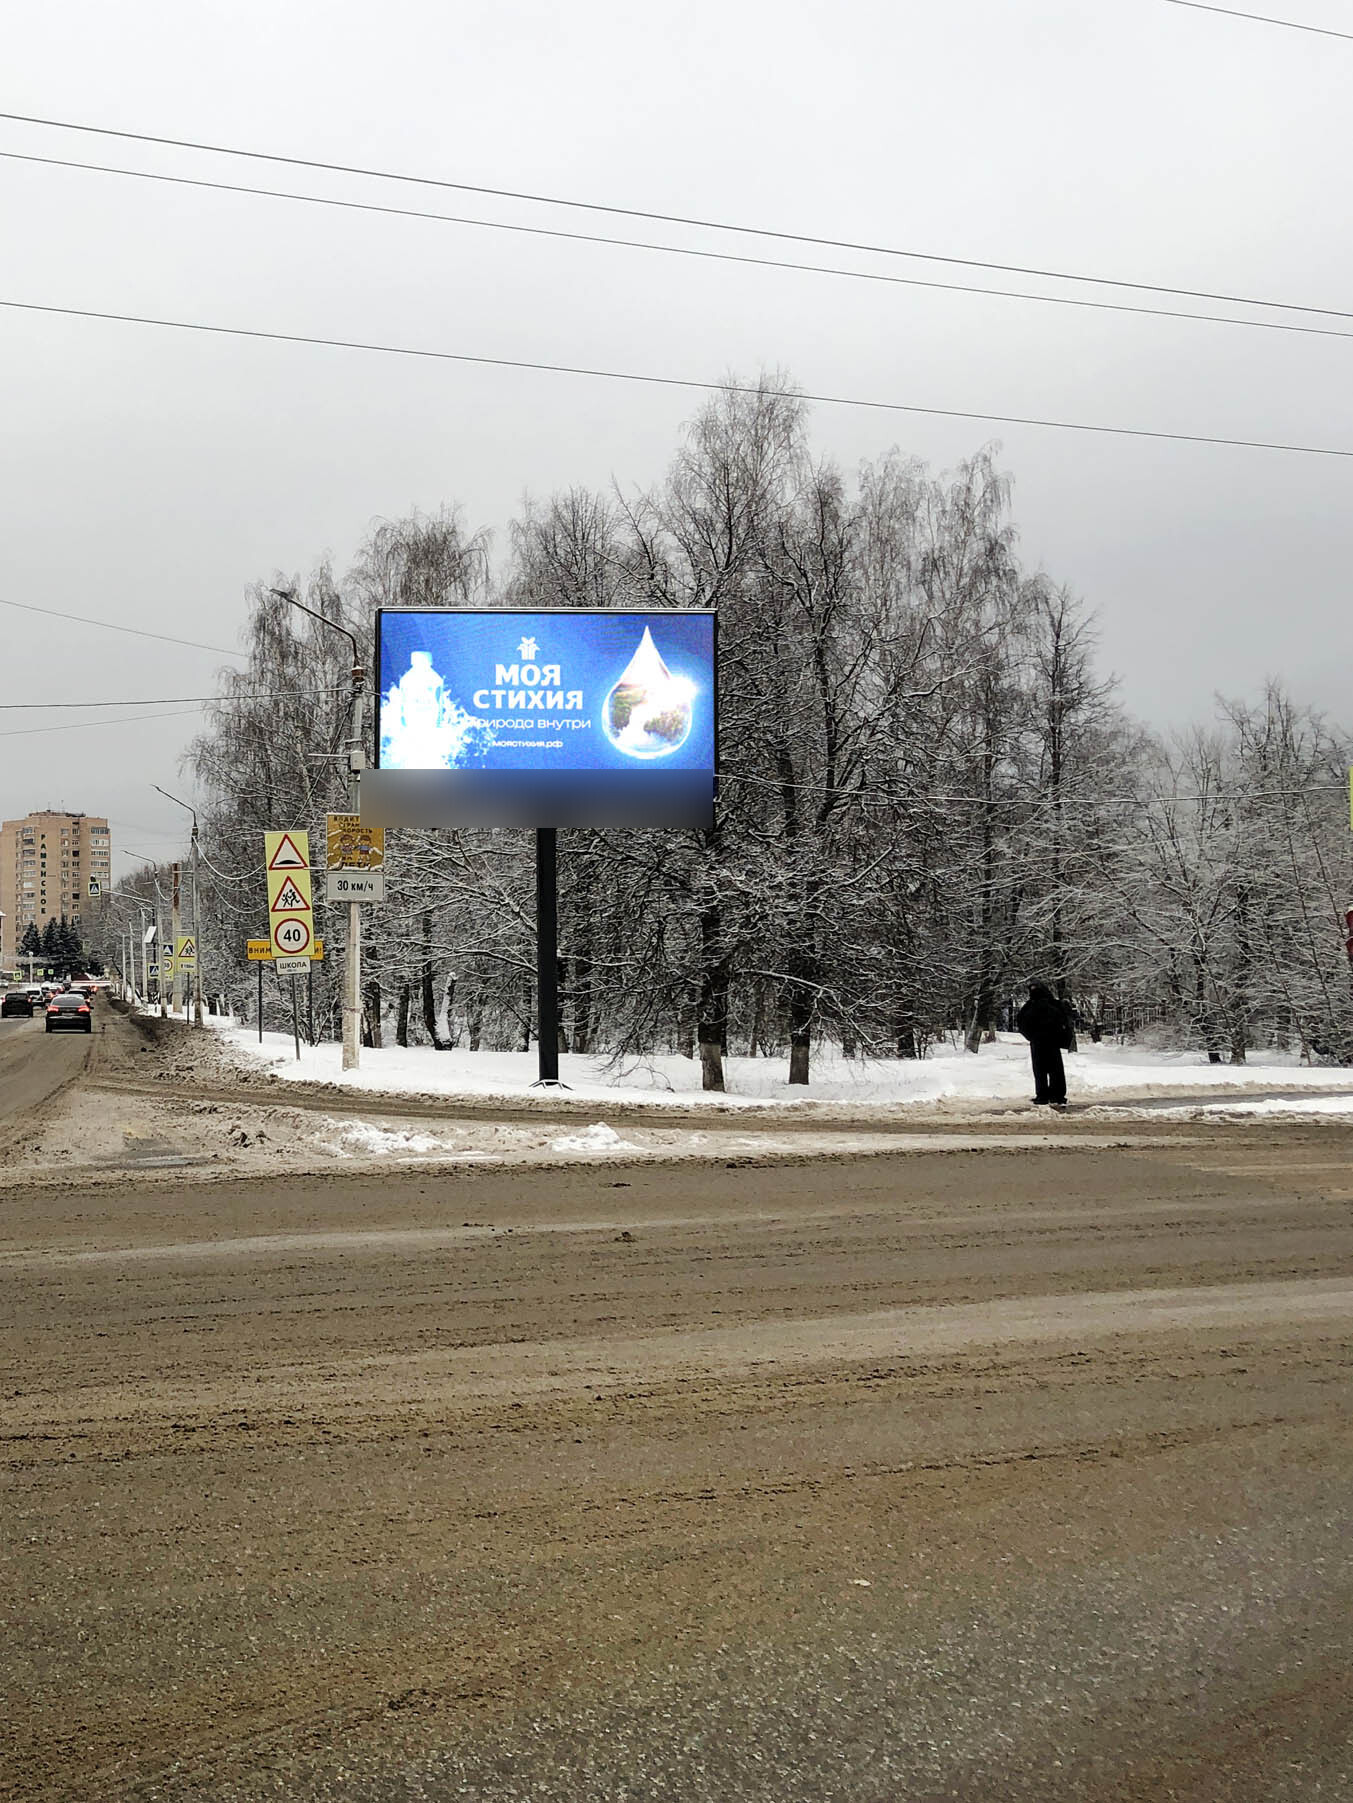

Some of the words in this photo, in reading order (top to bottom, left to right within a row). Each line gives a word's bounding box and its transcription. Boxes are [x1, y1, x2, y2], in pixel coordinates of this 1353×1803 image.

[495, 664, 561, 686] МОЯ
[473, 690, 583, 709] СТИХИЯ
[537, 719, 591, 730] внутри
[337, 880, 349, 891] 30
[351, 881, 374, 892] км/ч
[283, 929, 301, 942] 40
[279, 961, 307, 969] ШКОЛА
